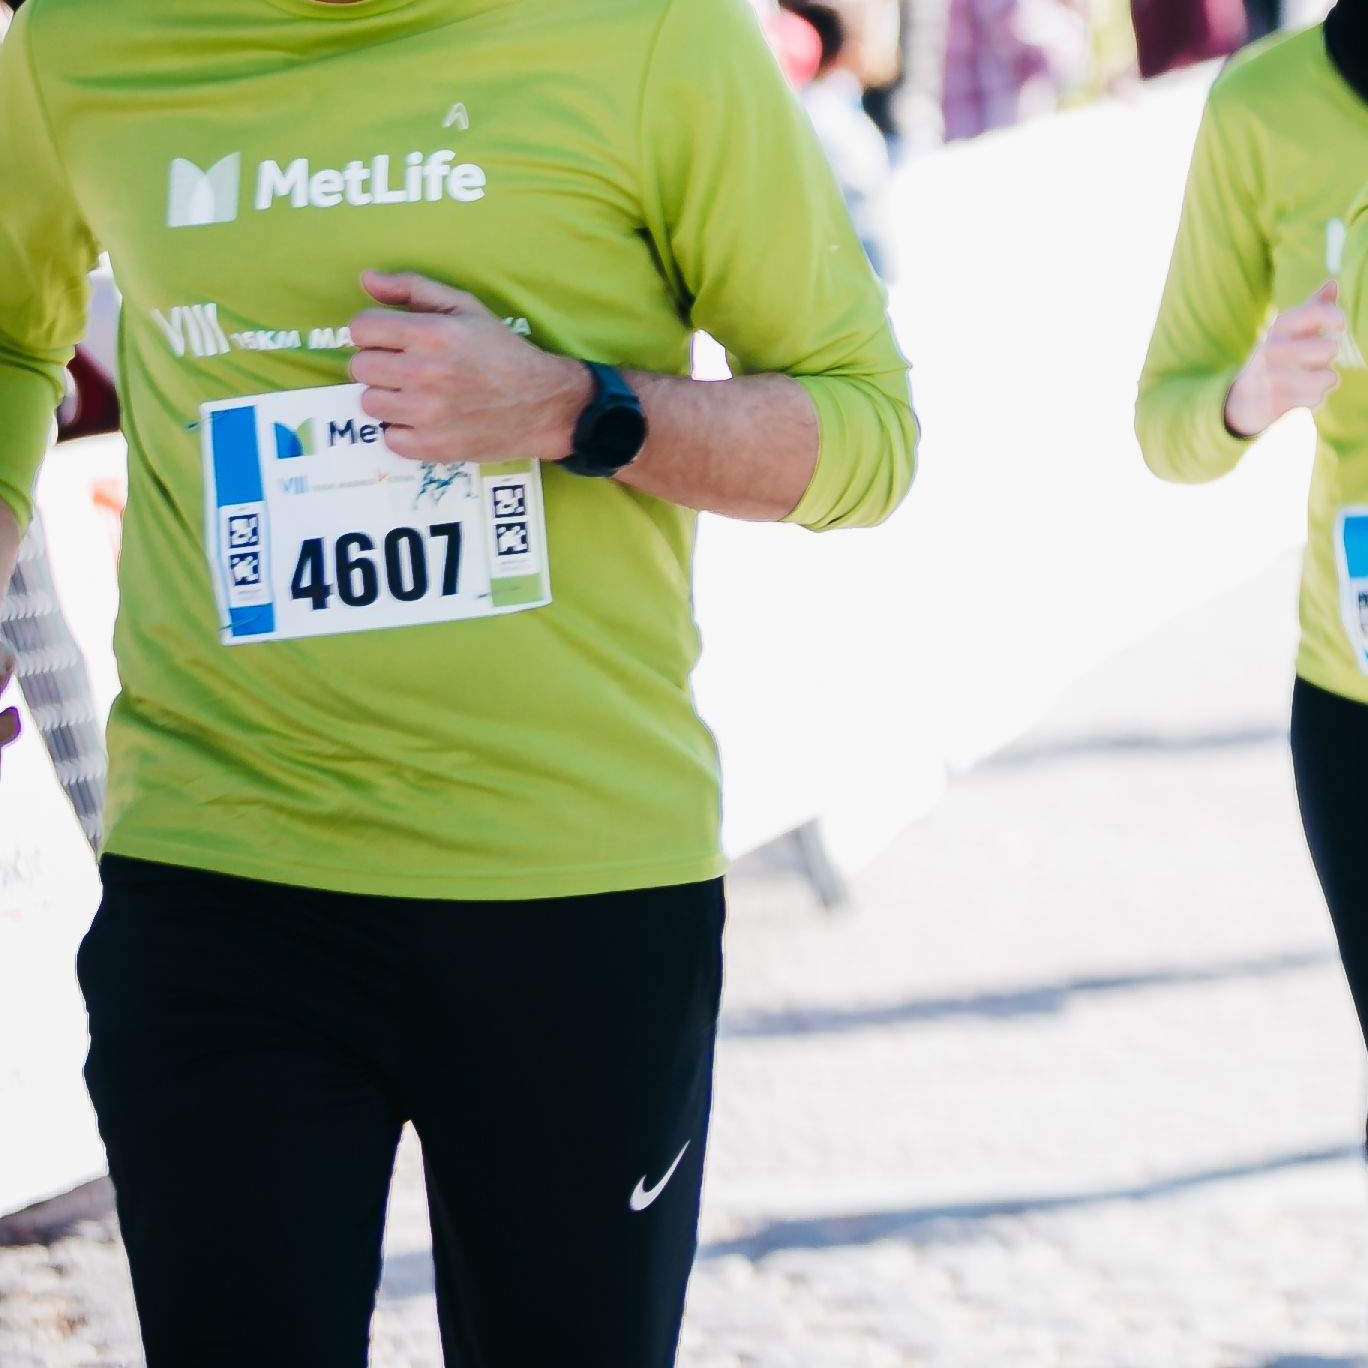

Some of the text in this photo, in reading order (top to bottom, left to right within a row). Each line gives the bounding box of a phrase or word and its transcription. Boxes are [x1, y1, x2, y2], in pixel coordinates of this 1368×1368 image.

[255, 150, 488, 211] MetLife
[328, 417, 387, 448] Me
[290, 520, 464, 611] 4607
